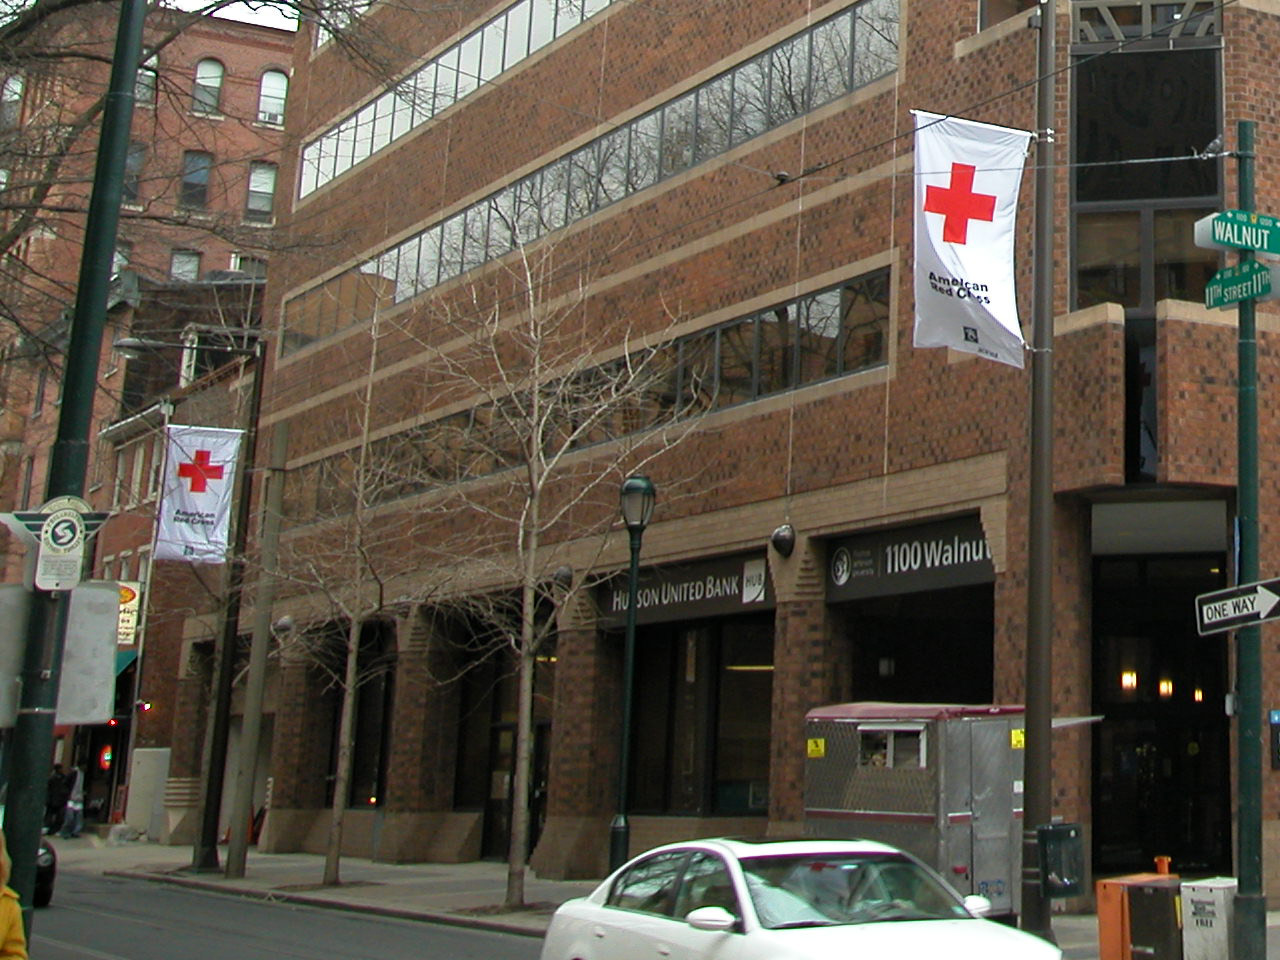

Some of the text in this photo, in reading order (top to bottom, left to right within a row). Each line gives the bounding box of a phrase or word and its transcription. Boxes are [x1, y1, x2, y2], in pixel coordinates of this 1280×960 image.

[1214, 220, 1270, 249] WALNUT
[929, 271, 989, 292] Ameican
[930, 282, 991, 304] Red Crss
[1223, 281, 1252, 302] STREET
[885, 540, 922, 574] 1100
[923, 535, 992, 569] Walnut
[745, 572, 763, 588] HUB
[612, 575, 740, 612] HUSON UNITED BANK
[1206, 596, 1256, 621] ONE WAY
